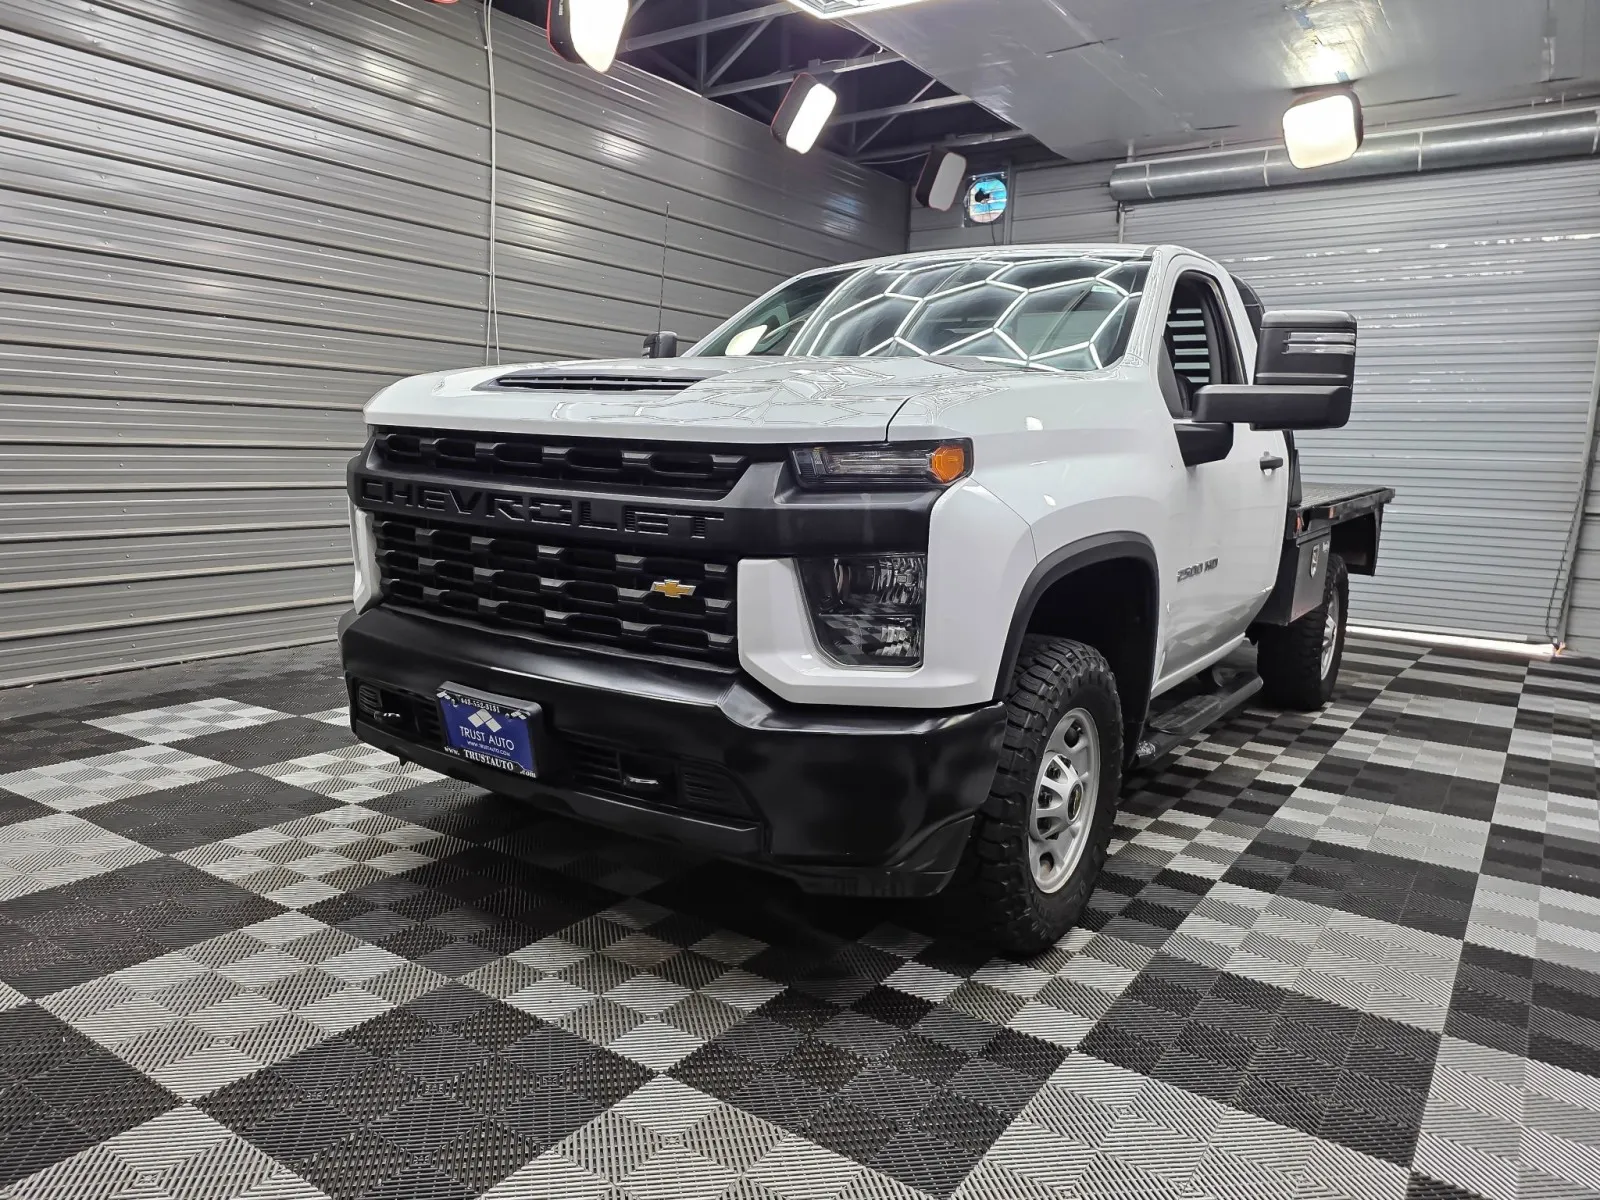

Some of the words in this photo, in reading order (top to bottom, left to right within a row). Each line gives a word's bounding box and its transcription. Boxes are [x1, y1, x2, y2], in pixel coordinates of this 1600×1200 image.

[362, 478, 724, 539] CHEVROLET
[1177, 562, 1204, 583] 2500
[1204, 557, 1219, 572] HD
[459, 725, 486, 742] TRUST
[488, 735, 515, 751] AUTO
[463, 748, 514, 771] TRUSTAUTO
